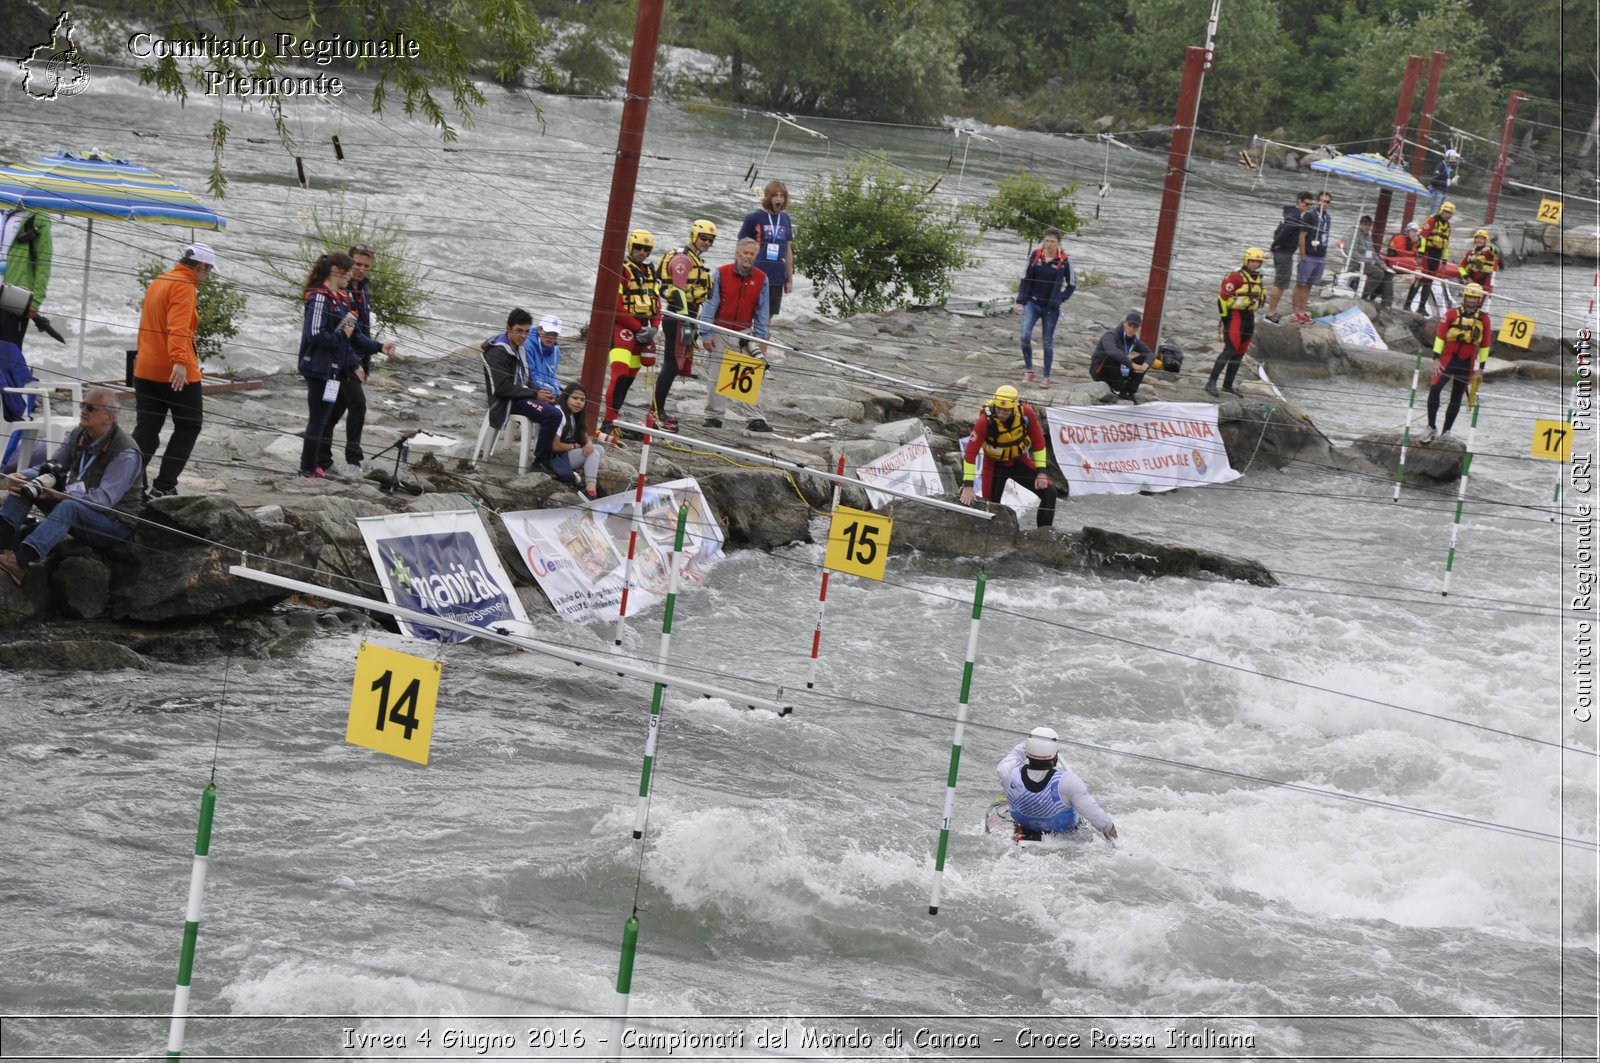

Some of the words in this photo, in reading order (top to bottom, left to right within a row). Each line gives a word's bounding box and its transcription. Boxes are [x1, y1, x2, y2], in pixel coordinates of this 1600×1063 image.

[1540, 204, 1559, 220] 22
[1508, 319, 1528, 340] 19
[729, 363, 755, 394] 16
[1059, 425, 1099, 445] CROCE
[1103, 423, 1142, 443] ROSSA
[1144, 421, 1214, 440] ITALIANA
[1542, 427, 1567, 453] 17
[843, 521, 879, 565] 15
[410, 559, 502, 609] manital
[371, 669, 421, 741] 14
